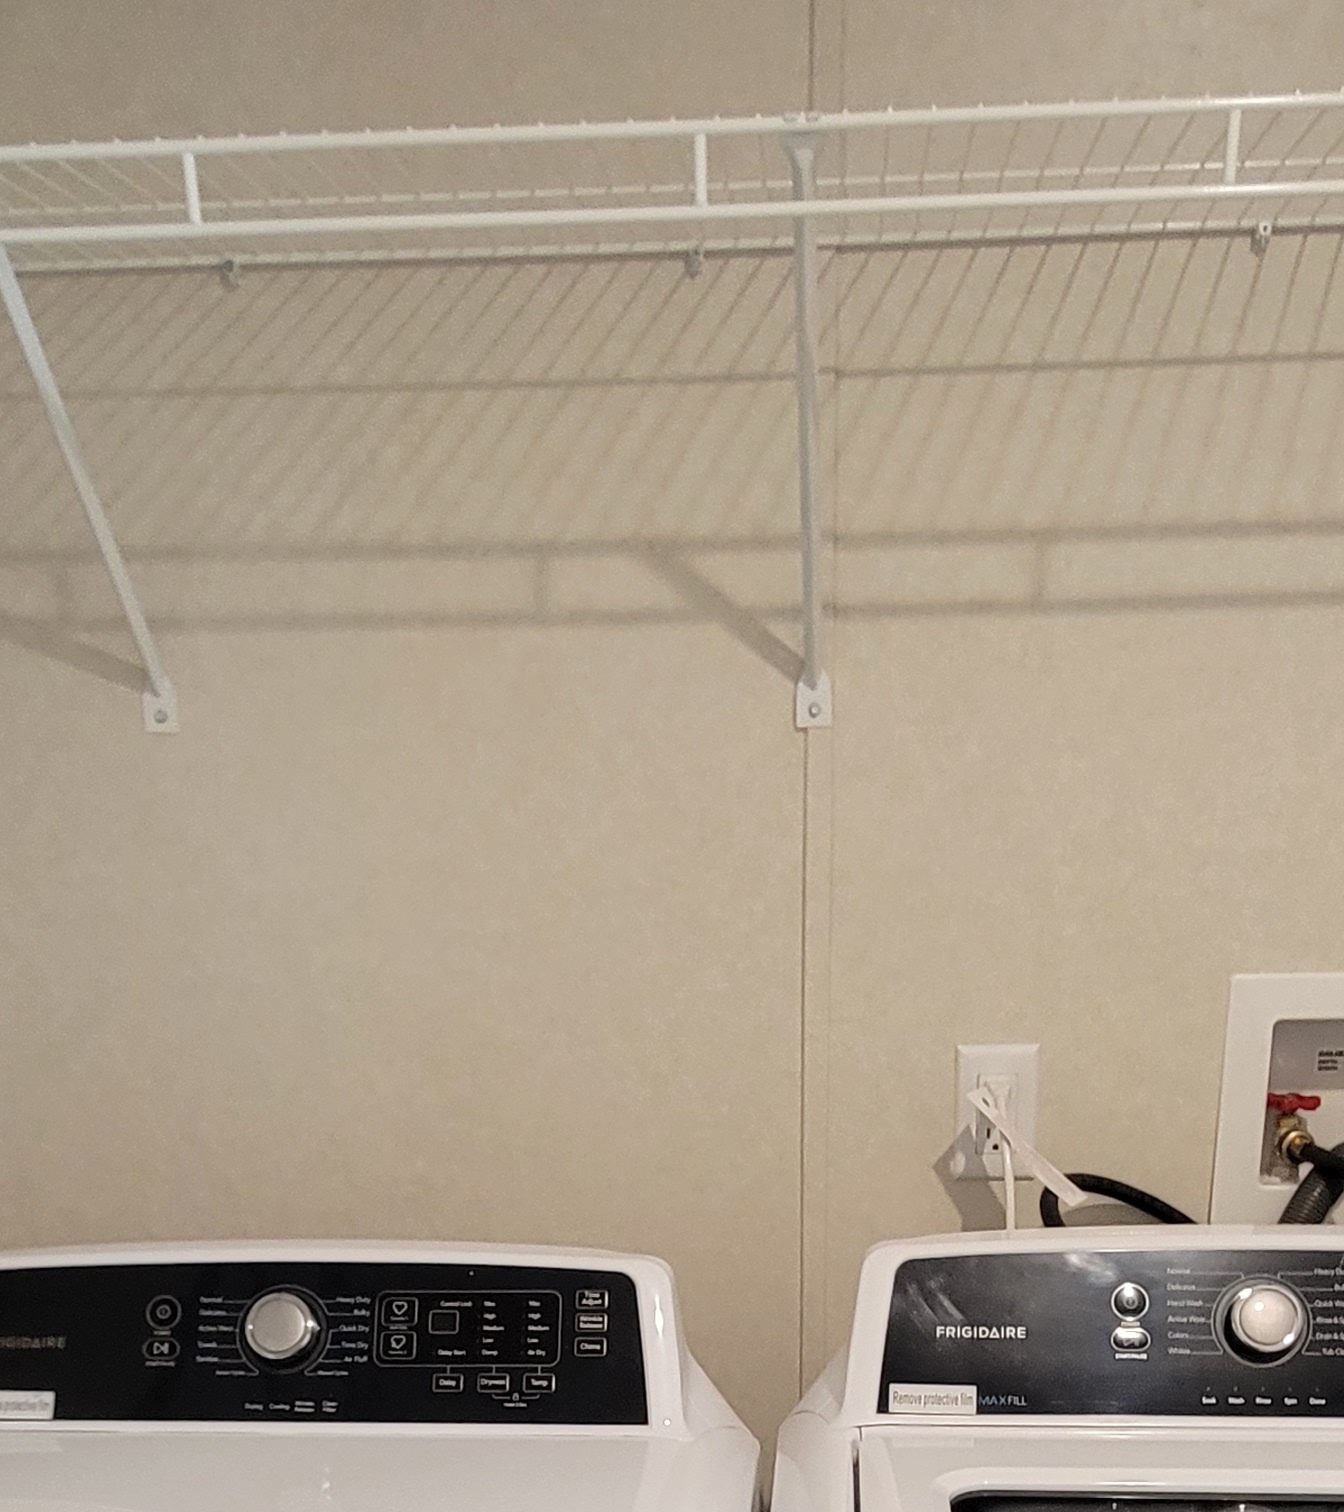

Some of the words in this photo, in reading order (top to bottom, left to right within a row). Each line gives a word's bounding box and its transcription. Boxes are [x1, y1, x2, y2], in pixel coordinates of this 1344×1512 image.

[935, 1325, 1027, 1339] FRIGIDAIRE
[893, 1391, 922, 1405] Remove
[923, 1392, 958, 1408] protective
[960, 1393, 974, 1406] film
